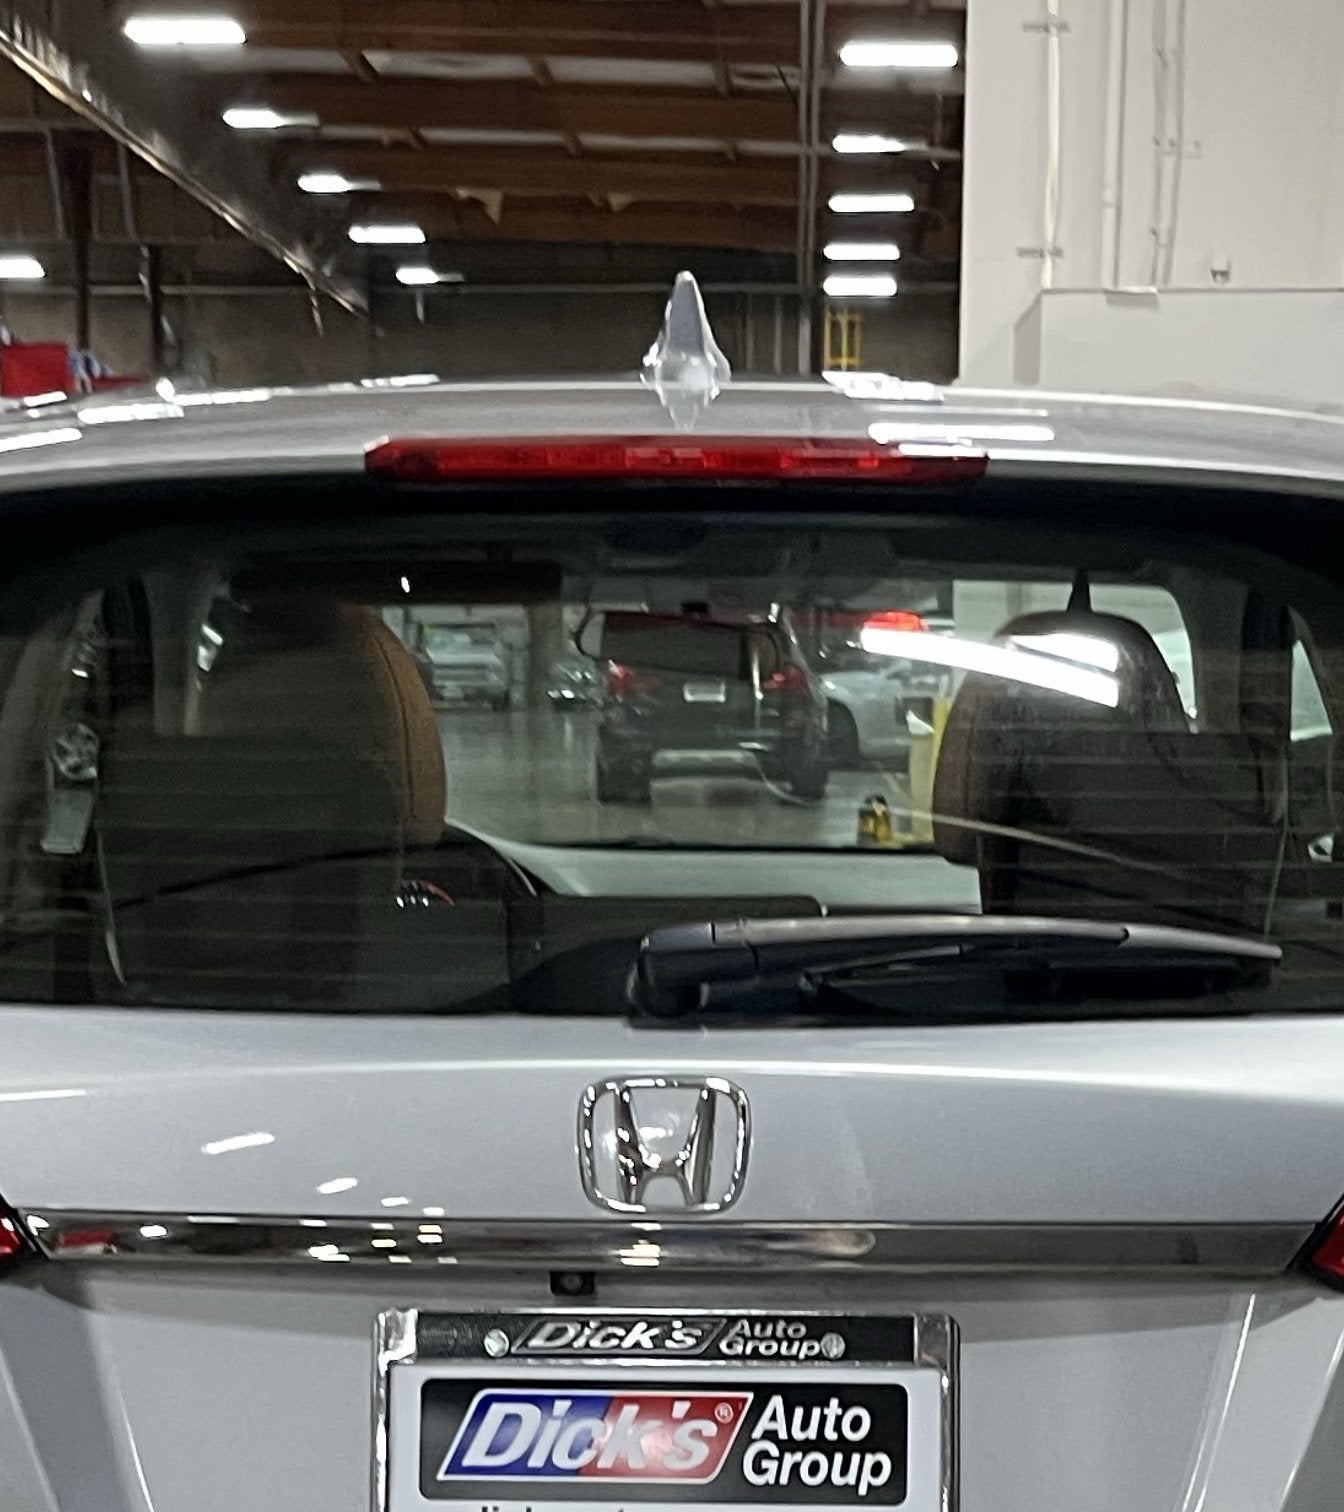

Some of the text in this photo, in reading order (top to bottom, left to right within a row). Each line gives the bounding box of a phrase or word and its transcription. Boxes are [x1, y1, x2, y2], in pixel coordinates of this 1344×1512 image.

[527, 1319, 702, 1350] Dick's
[728, 1318, 808, 1339] Auto
[718, 1338, 821, 1361] Group
[462, 1398, 718, 1471] Dick's
[751, 1394, 871, 1443] Auto
[741, 1446, 893, 1495] Group
